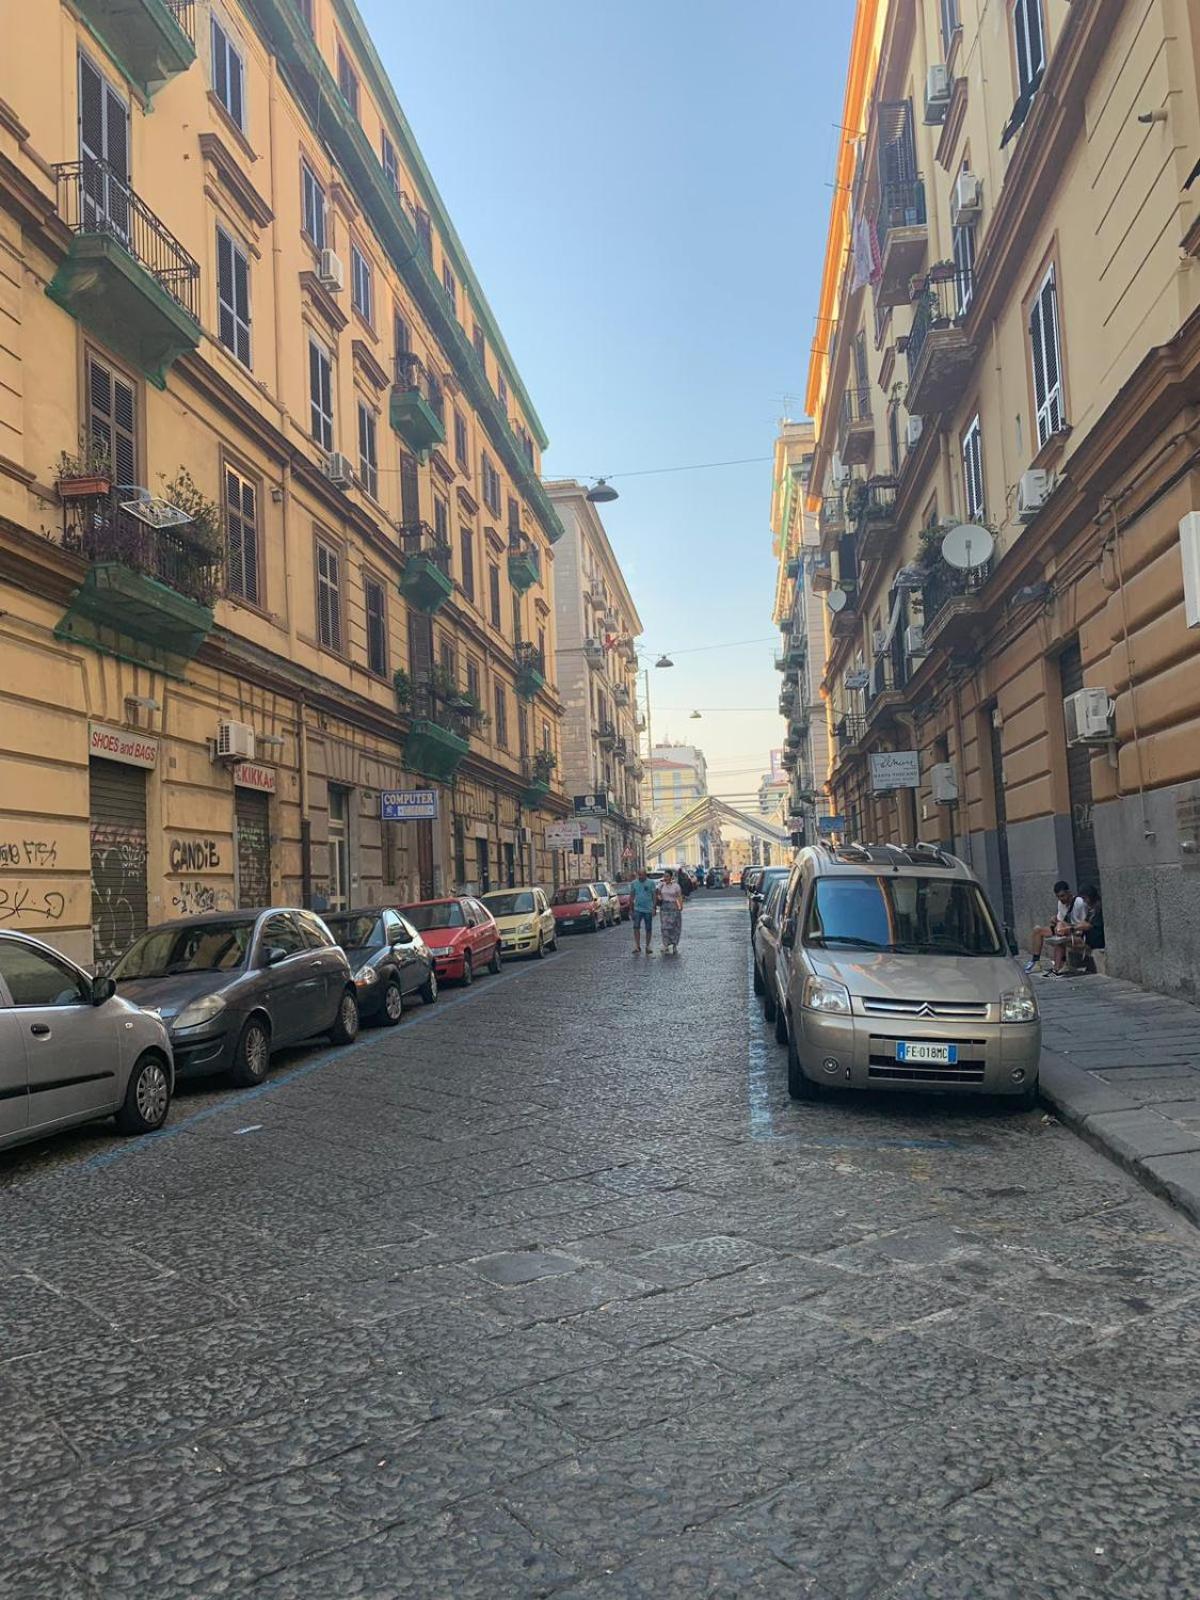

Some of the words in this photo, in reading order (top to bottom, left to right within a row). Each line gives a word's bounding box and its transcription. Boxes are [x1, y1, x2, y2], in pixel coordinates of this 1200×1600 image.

[92, 732, 119, 753] SHOES
[120, 742, 134, 757] and
[135, 744, 156, 762] BAGS
[384, 793, 433, 805] COMPUTER
